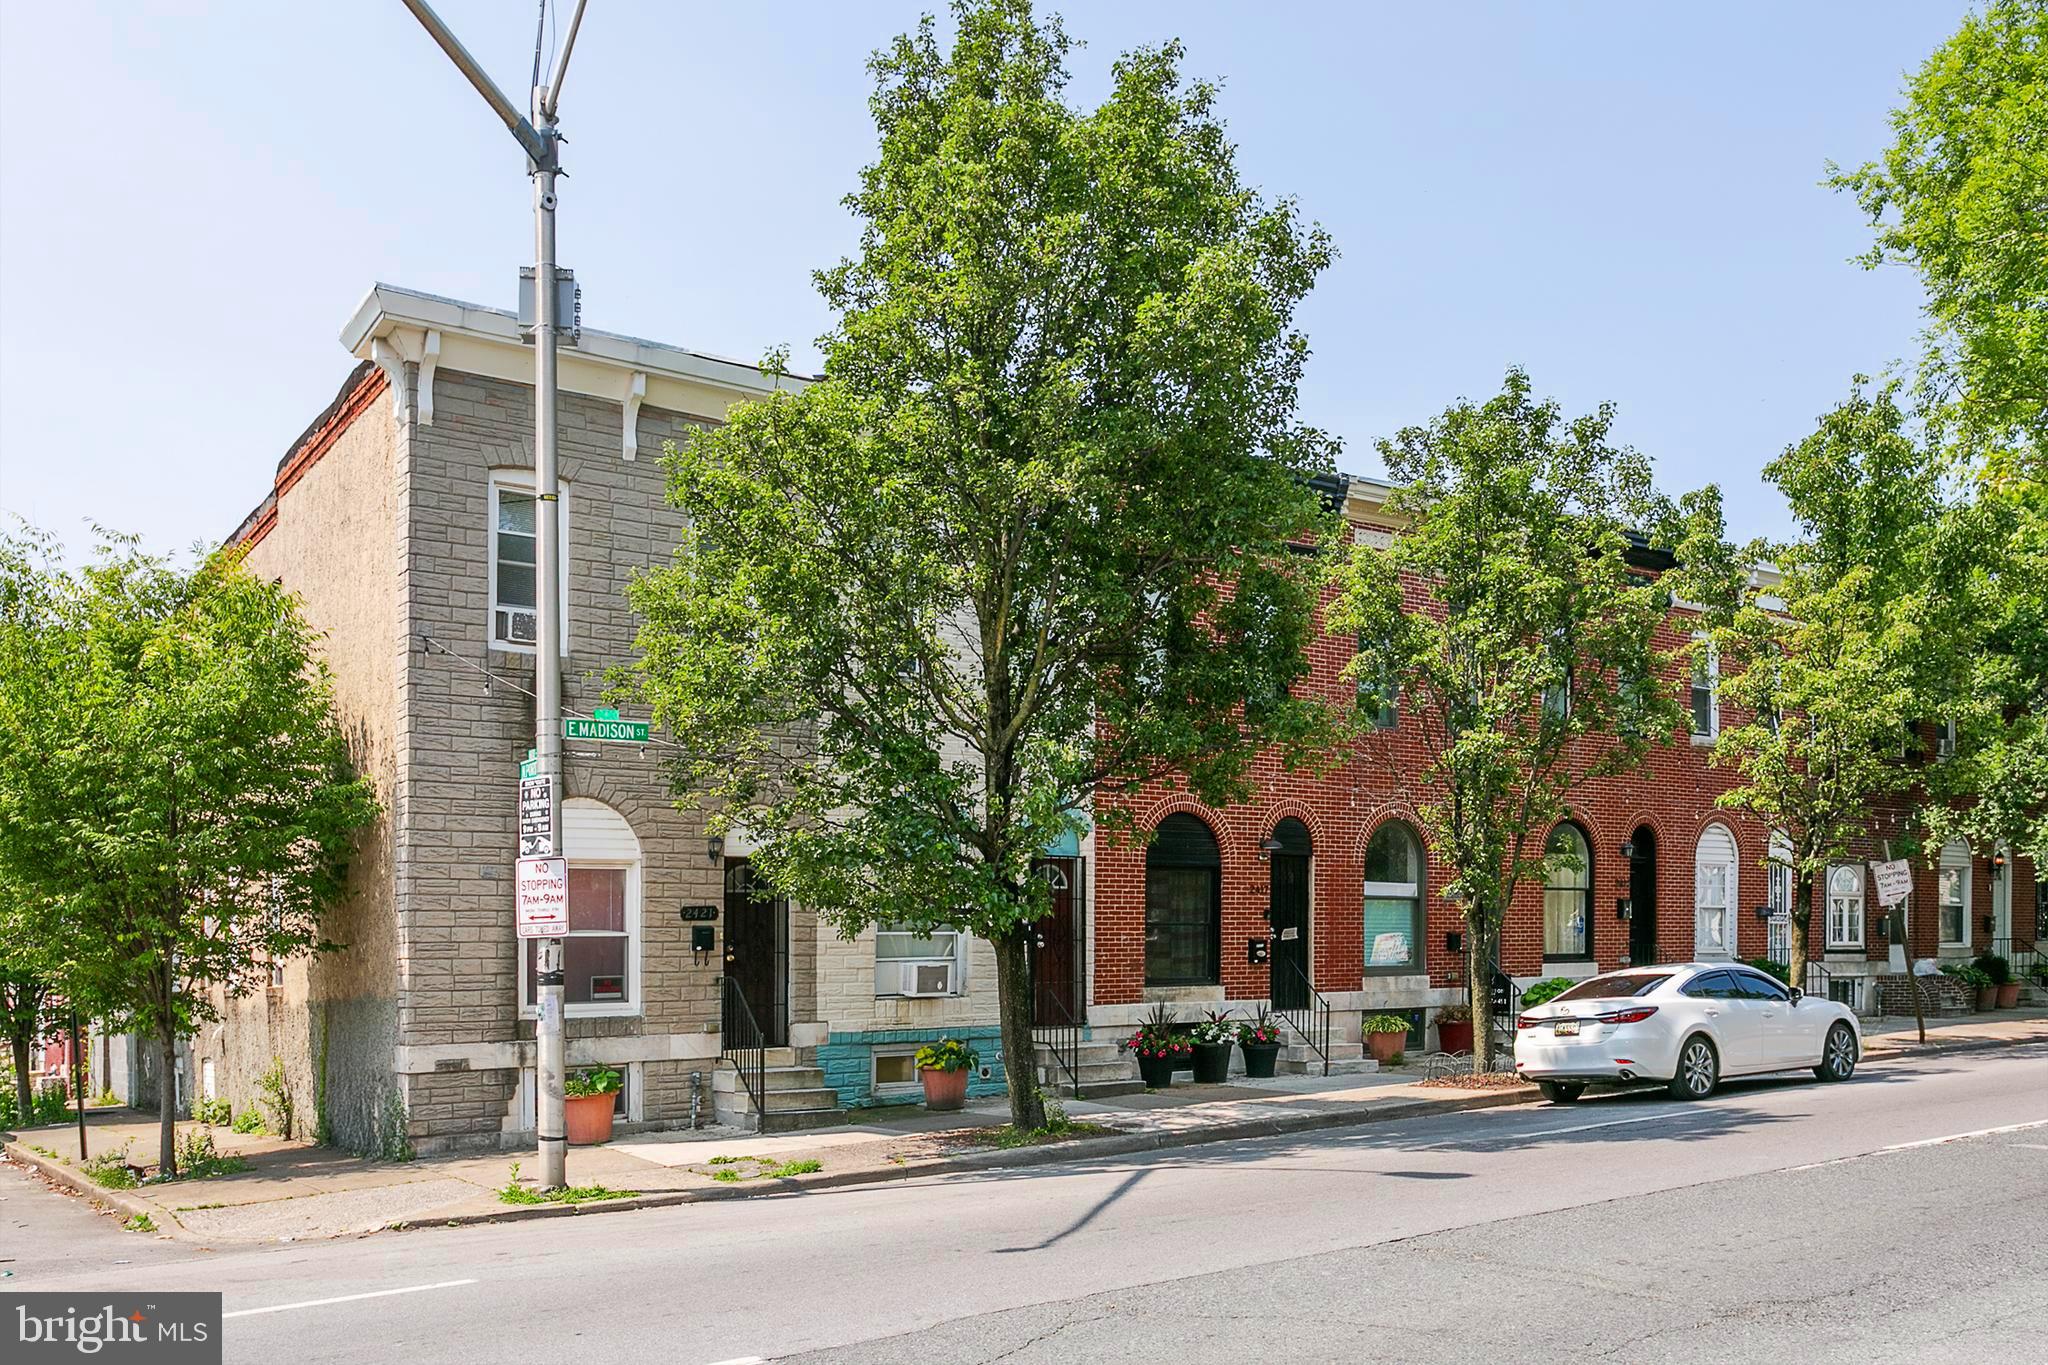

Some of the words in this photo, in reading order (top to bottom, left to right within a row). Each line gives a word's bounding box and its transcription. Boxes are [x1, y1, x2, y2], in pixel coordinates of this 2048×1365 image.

[579, 722, 635, 739] MADISON
[530, 787, 542, 799] NO
[522, 798, 550, 811] PARKING
[535, 863, 549, 873] NO
[1877, 869, 1907, 881] STOPPING
[521, 878, 563, 891] STOPPING
[685, 908, 713, 919] 2421
